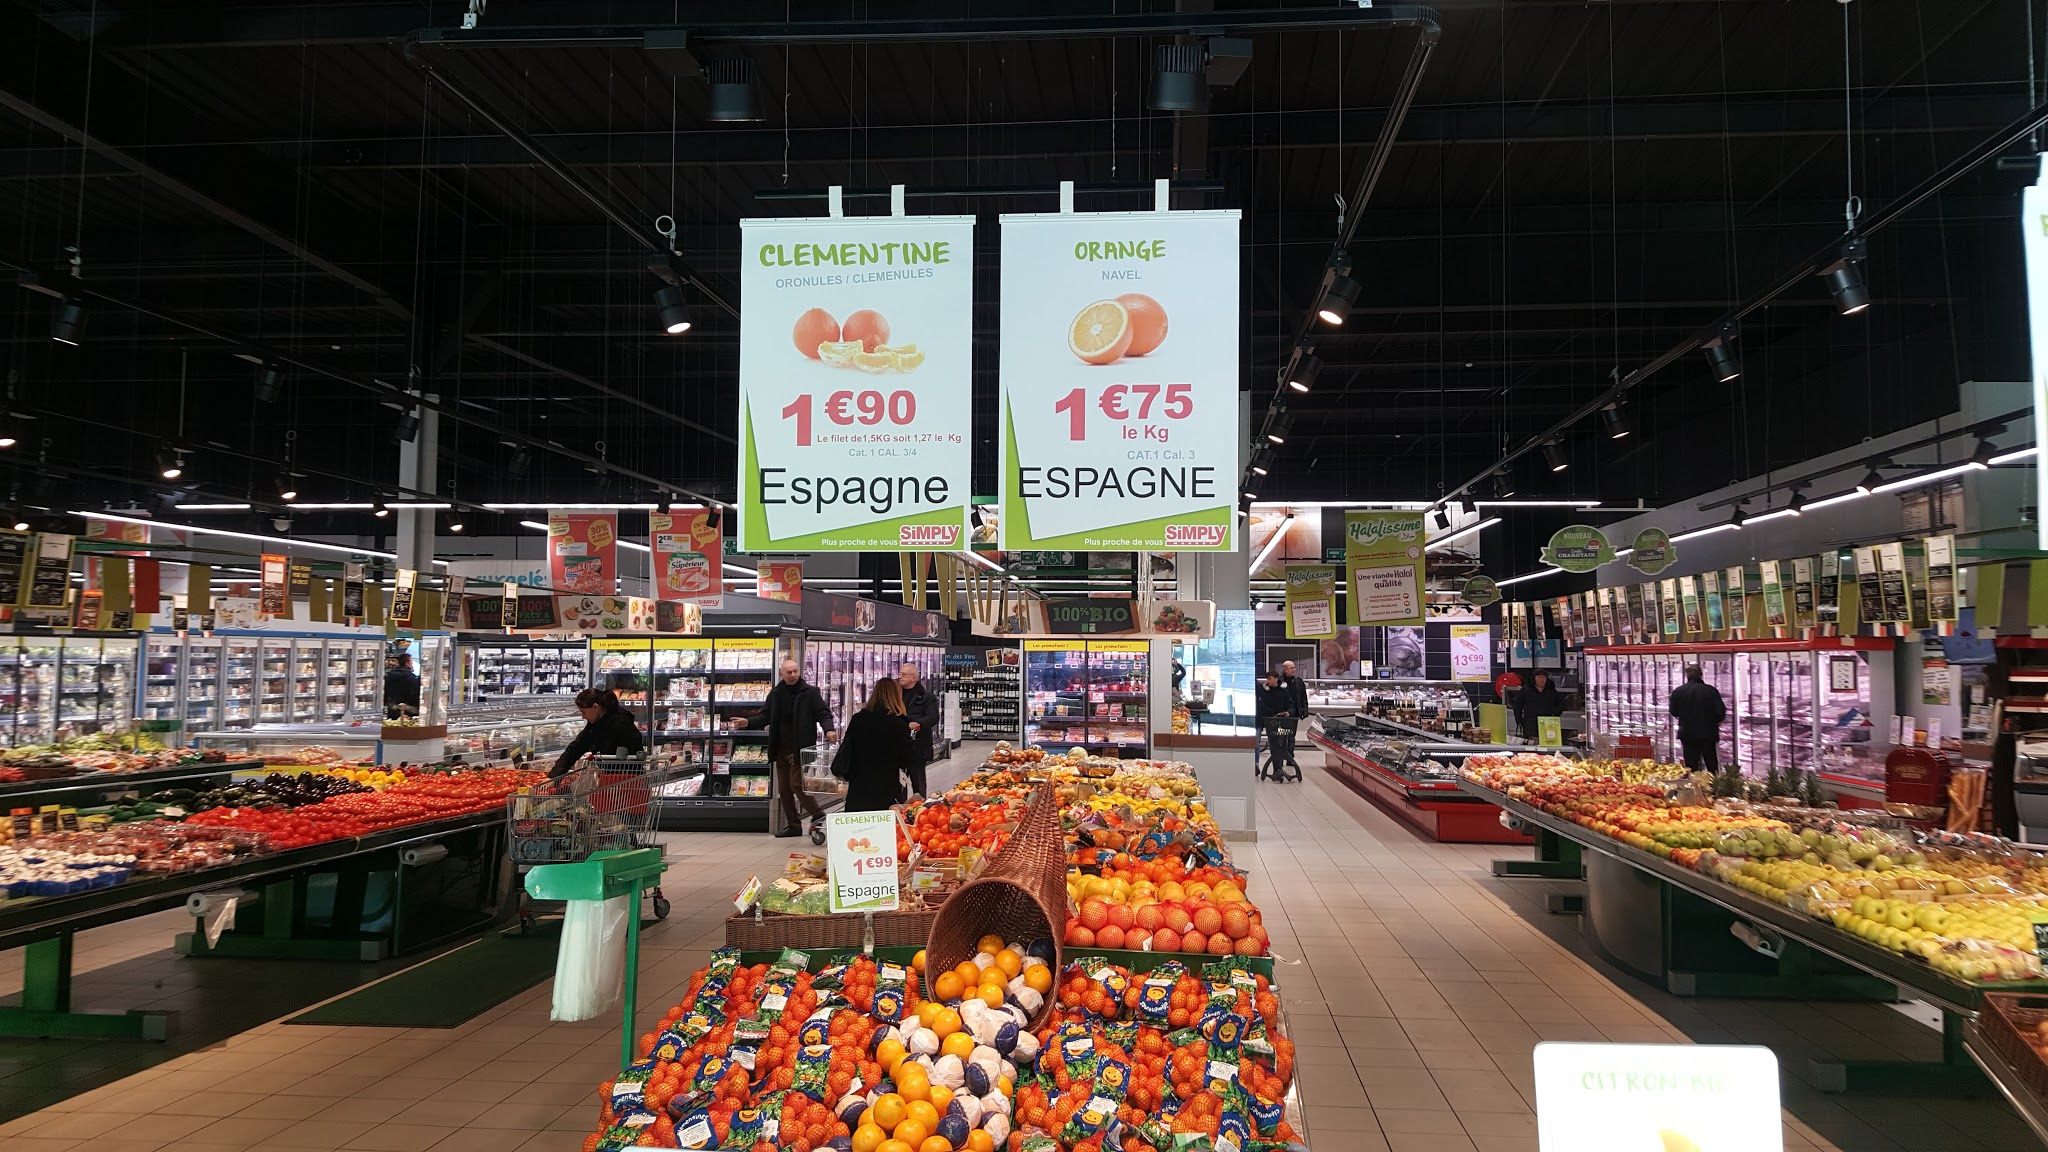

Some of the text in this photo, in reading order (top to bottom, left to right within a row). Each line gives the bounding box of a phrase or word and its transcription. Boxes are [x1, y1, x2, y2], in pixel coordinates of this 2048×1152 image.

[760, 241, 950, 267] CLEMENTINE
[1074, 239, 1166, 261] ORANGE
[775, 267, 934, 289] ORONULES / CLEMENULES
[1101, 269, 1142, 281] NAVEL
[817, 435, 829, 443] Le
[831, 434, 849, 442] filet
[893, 434, 911, 443] soit
[913, 434, 932, 444] 1,27
[935, 433, 943, 442] le
[948, 433, 962, 444] Kg
[1122, 424, 1169, 442] le Kg
[848, 448, 917, 457] Cat. 1 CAL. 3/4
[1163, 450, 1185, 460] Cal.
[1188, 450, 1196, 460] 3
[1018, 466, 1216, 499] ESPAGNE
[759, 467, 949, 514] Espagne
[900, 525, 961, 541] SiMPLY
[1165, 525, 1227, 541] SiMPLY
[1350, 520, 1421, 540] Halalissime
[821, 538, 837, 546] Plus
[839, 538, 866, 548] proche
[868, 538, 878, 546] de
[1084, 538, 1100, 546] Plus
[1103, 538, 1130, 548] proche
[1132, 538, 1143, 546] de
[1394, 569, 1413, 578] Halal
[1374, 579, 1402, 589] qualité
[835, 815, 891, 825] CLEMENTINE
[837, 885, 895, 899] Espagne
[1581, 1071, 1678, 1092] CITRON
